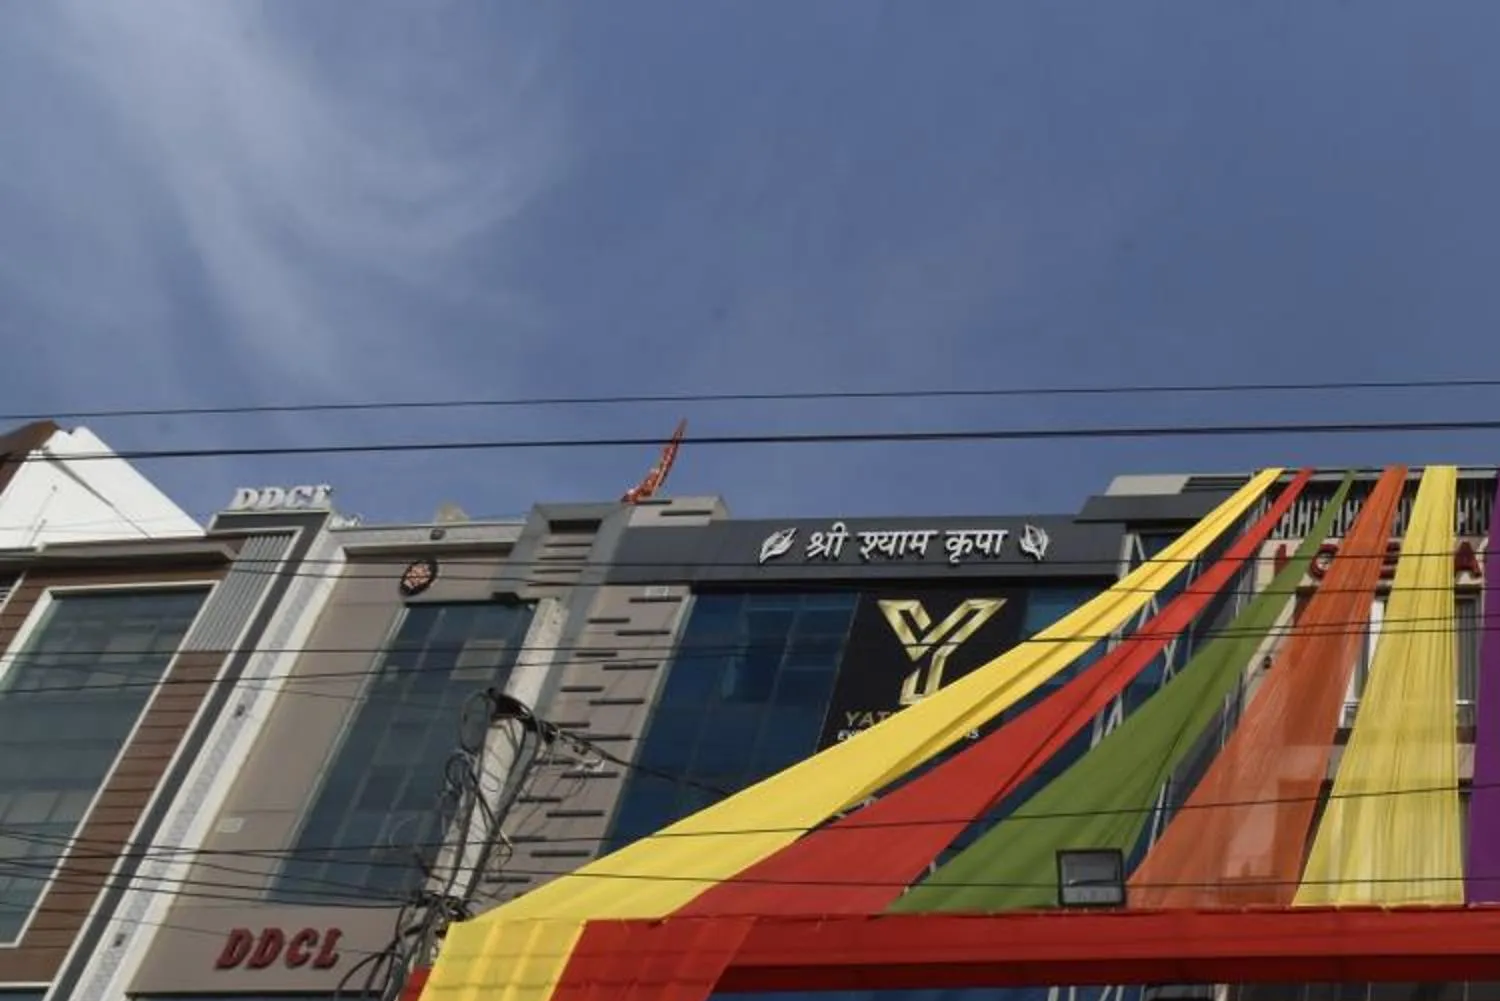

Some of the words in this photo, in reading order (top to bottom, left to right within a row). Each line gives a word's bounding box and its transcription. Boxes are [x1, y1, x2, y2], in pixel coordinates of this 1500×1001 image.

[806, 521, 849, 558] श्री
[857, 529, 938, 559] श्याम
[945, 529, 1009, 563] कृपा
[212, 927, 343, 969] DDCL
